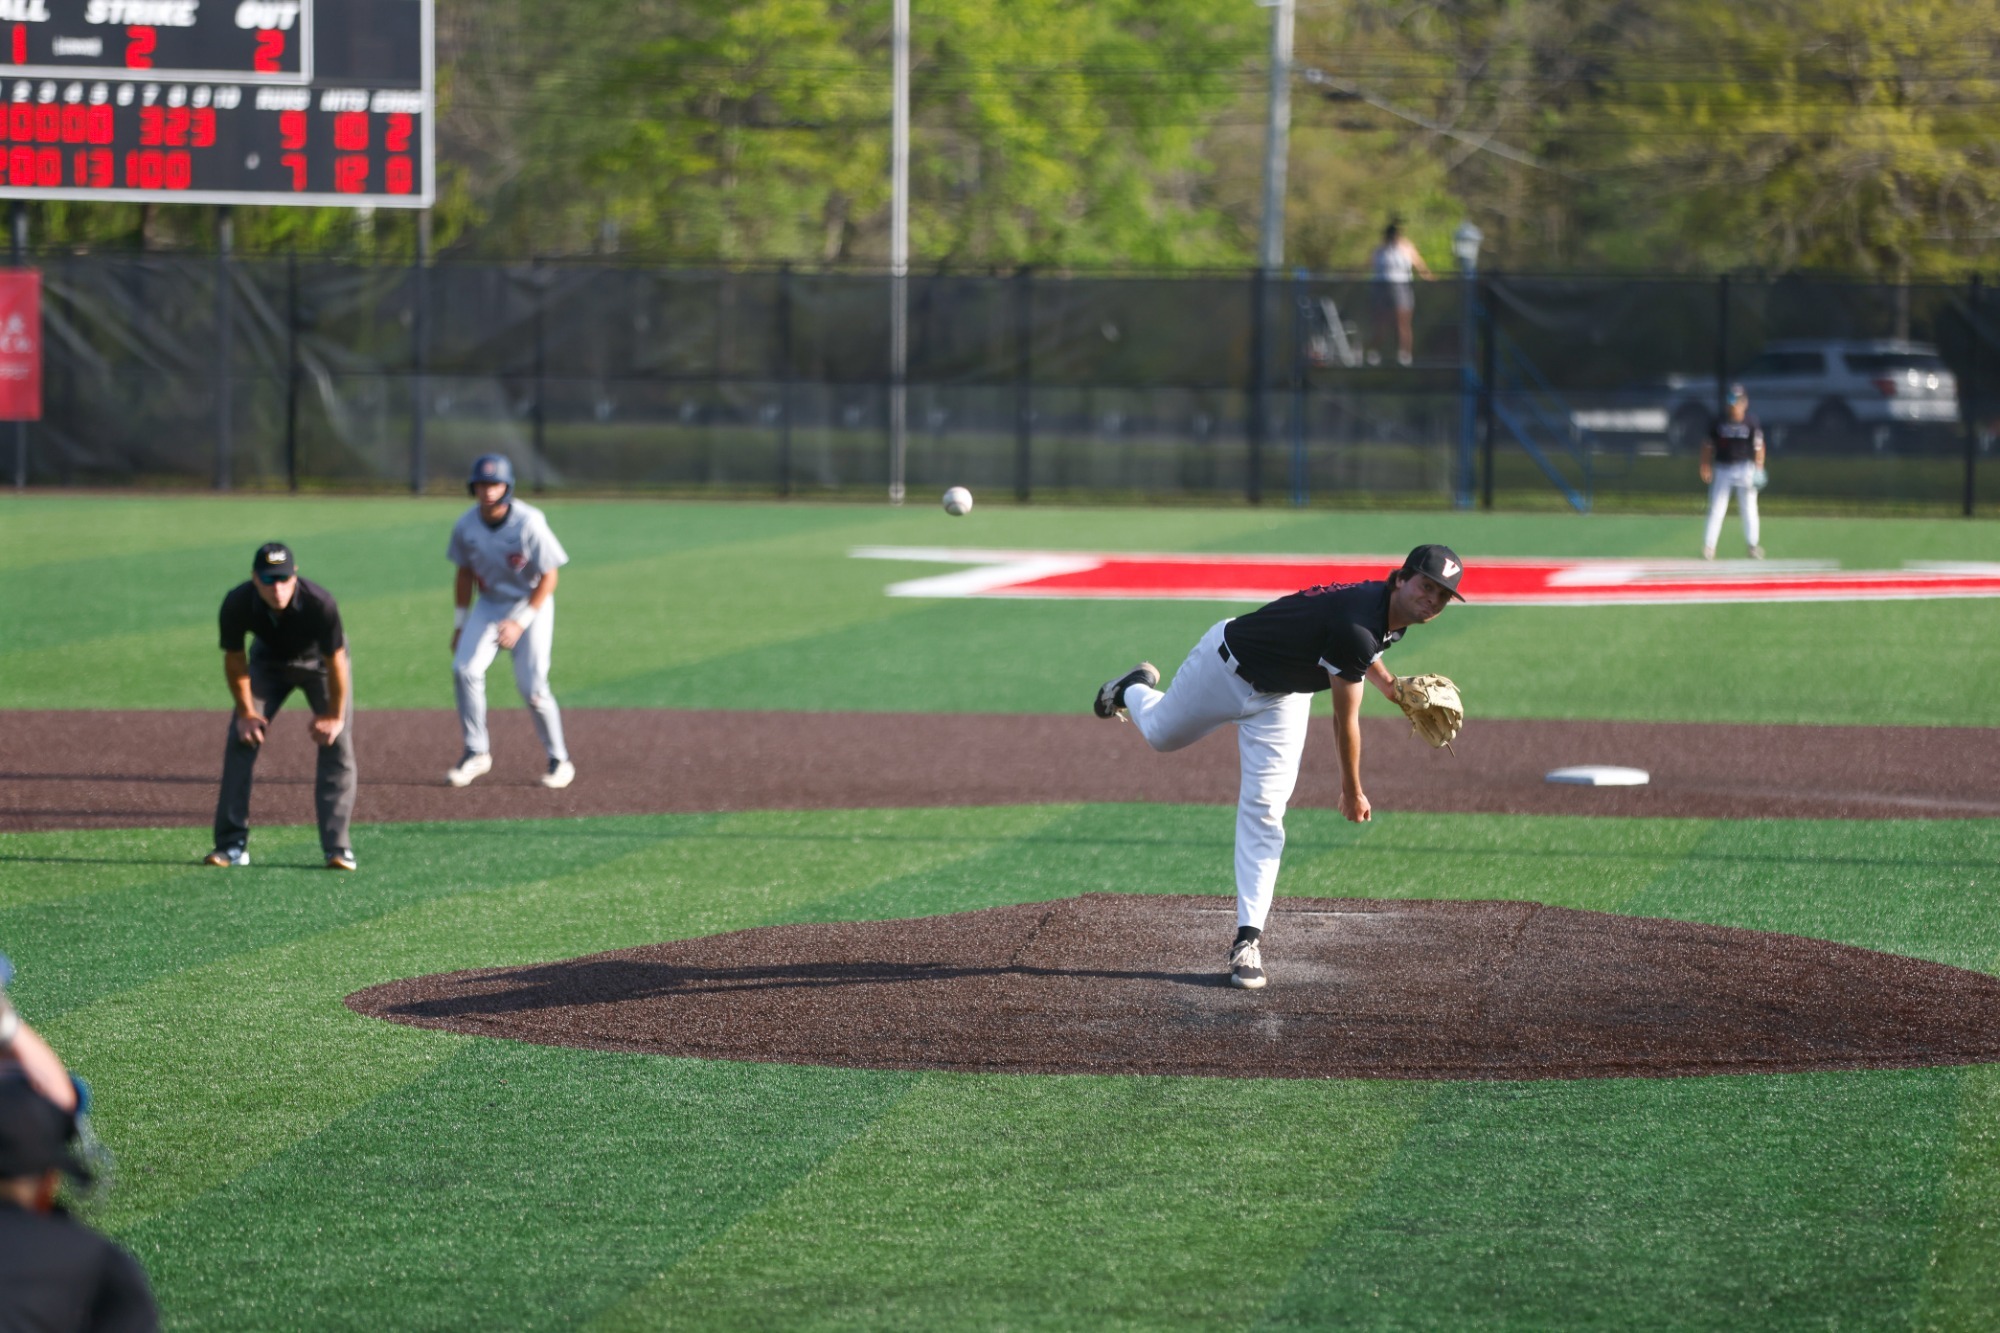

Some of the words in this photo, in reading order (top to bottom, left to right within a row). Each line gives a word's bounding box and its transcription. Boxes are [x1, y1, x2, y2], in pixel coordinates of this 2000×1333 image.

[85, 0, 200, 27] STRIKE
[234, 0, 300, 30] OUT
[125, 25, 157, 70] 2
[253, 28, 285, 74] 2
[385, 112, 412, 152] 2
[1442, 557, 1461, 578] V
